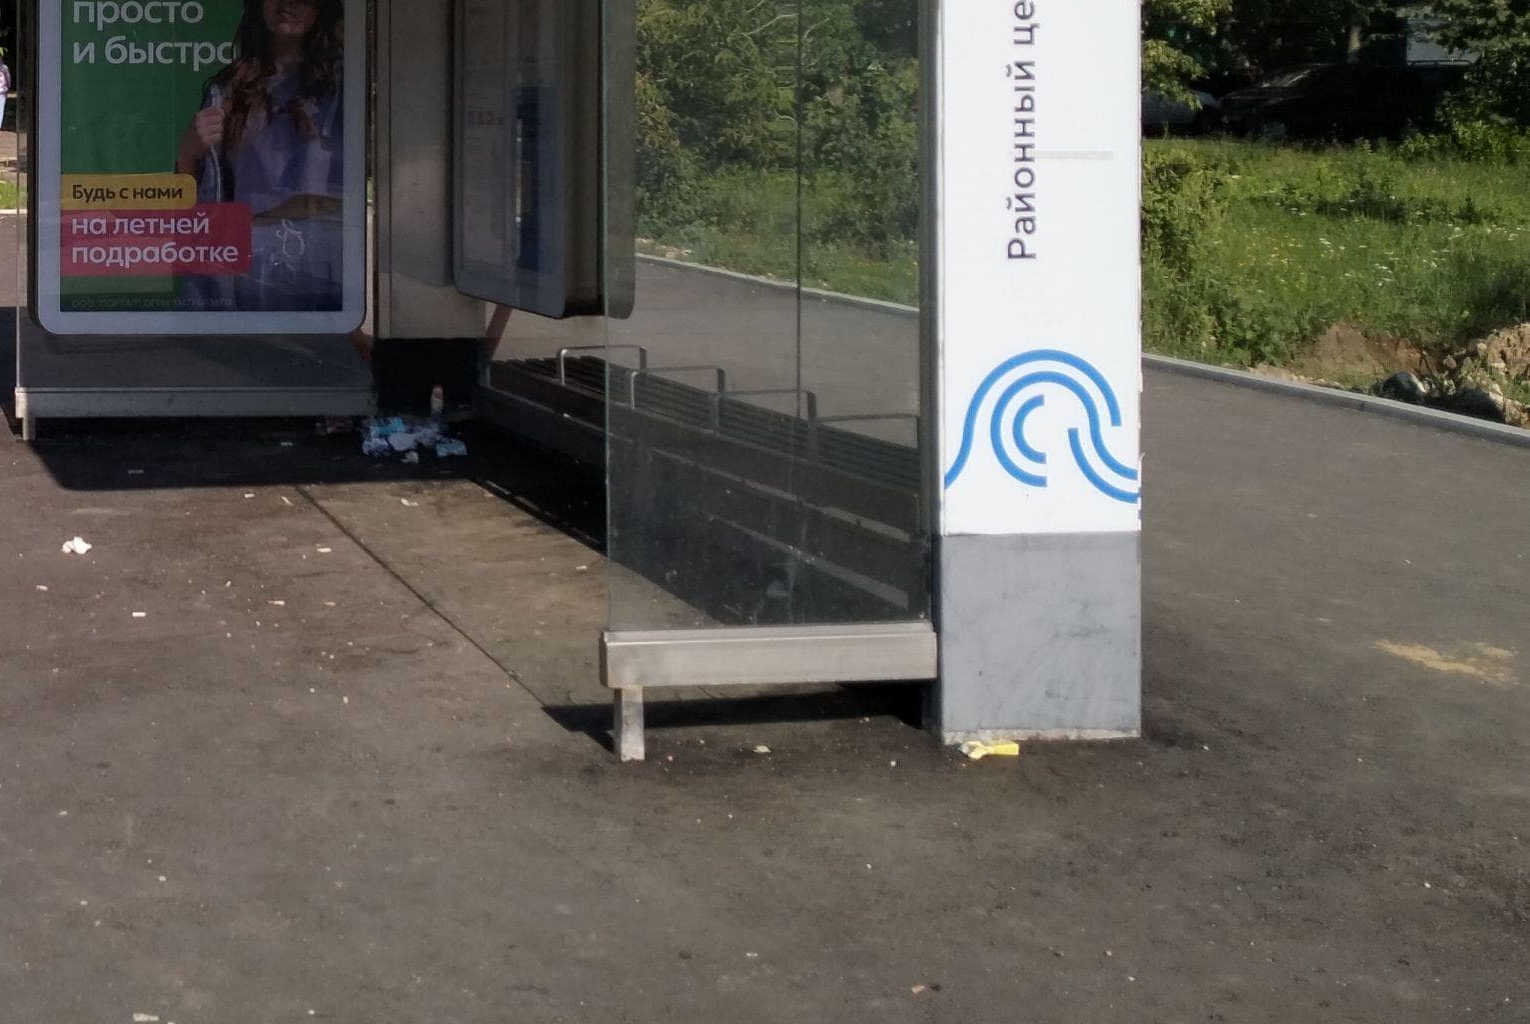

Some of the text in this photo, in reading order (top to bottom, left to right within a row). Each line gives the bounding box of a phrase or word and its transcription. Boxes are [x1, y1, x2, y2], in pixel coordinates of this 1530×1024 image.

[73, 1, 204, 31] просто
[73, 35, 238, 72] и быстро
[1006, 61, 1037, 260] Районный
[72, 184, 183, 202] Будь с нами
[72, 211, 210, 235] на летней
[72, 242, 238, 268] подработке
